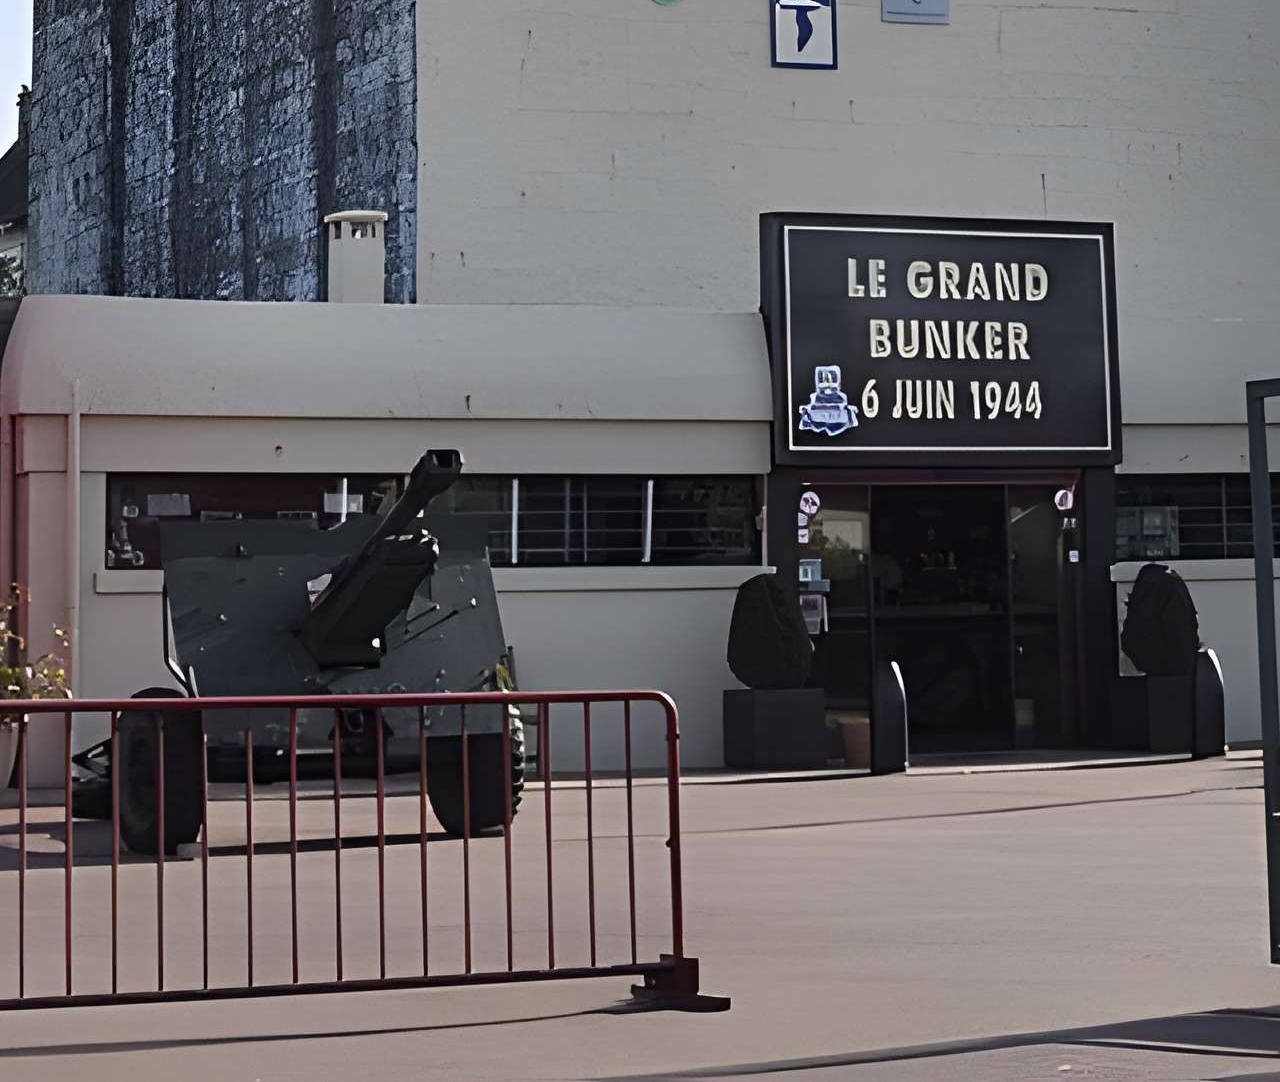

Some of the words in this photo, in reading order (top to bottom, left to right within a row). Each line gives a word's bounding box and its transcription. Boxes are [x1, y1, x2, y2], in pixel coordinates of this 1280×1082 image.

[847, 257, 887, 298] LE
[906, 260, 1049, 302] GRAND
[869, 318, 1031, 361] BUNKER
[861, 378, 880, 418] 6
[891, 379, 955, 420] JUIN
[969, 380, 1043, 420] 1944
